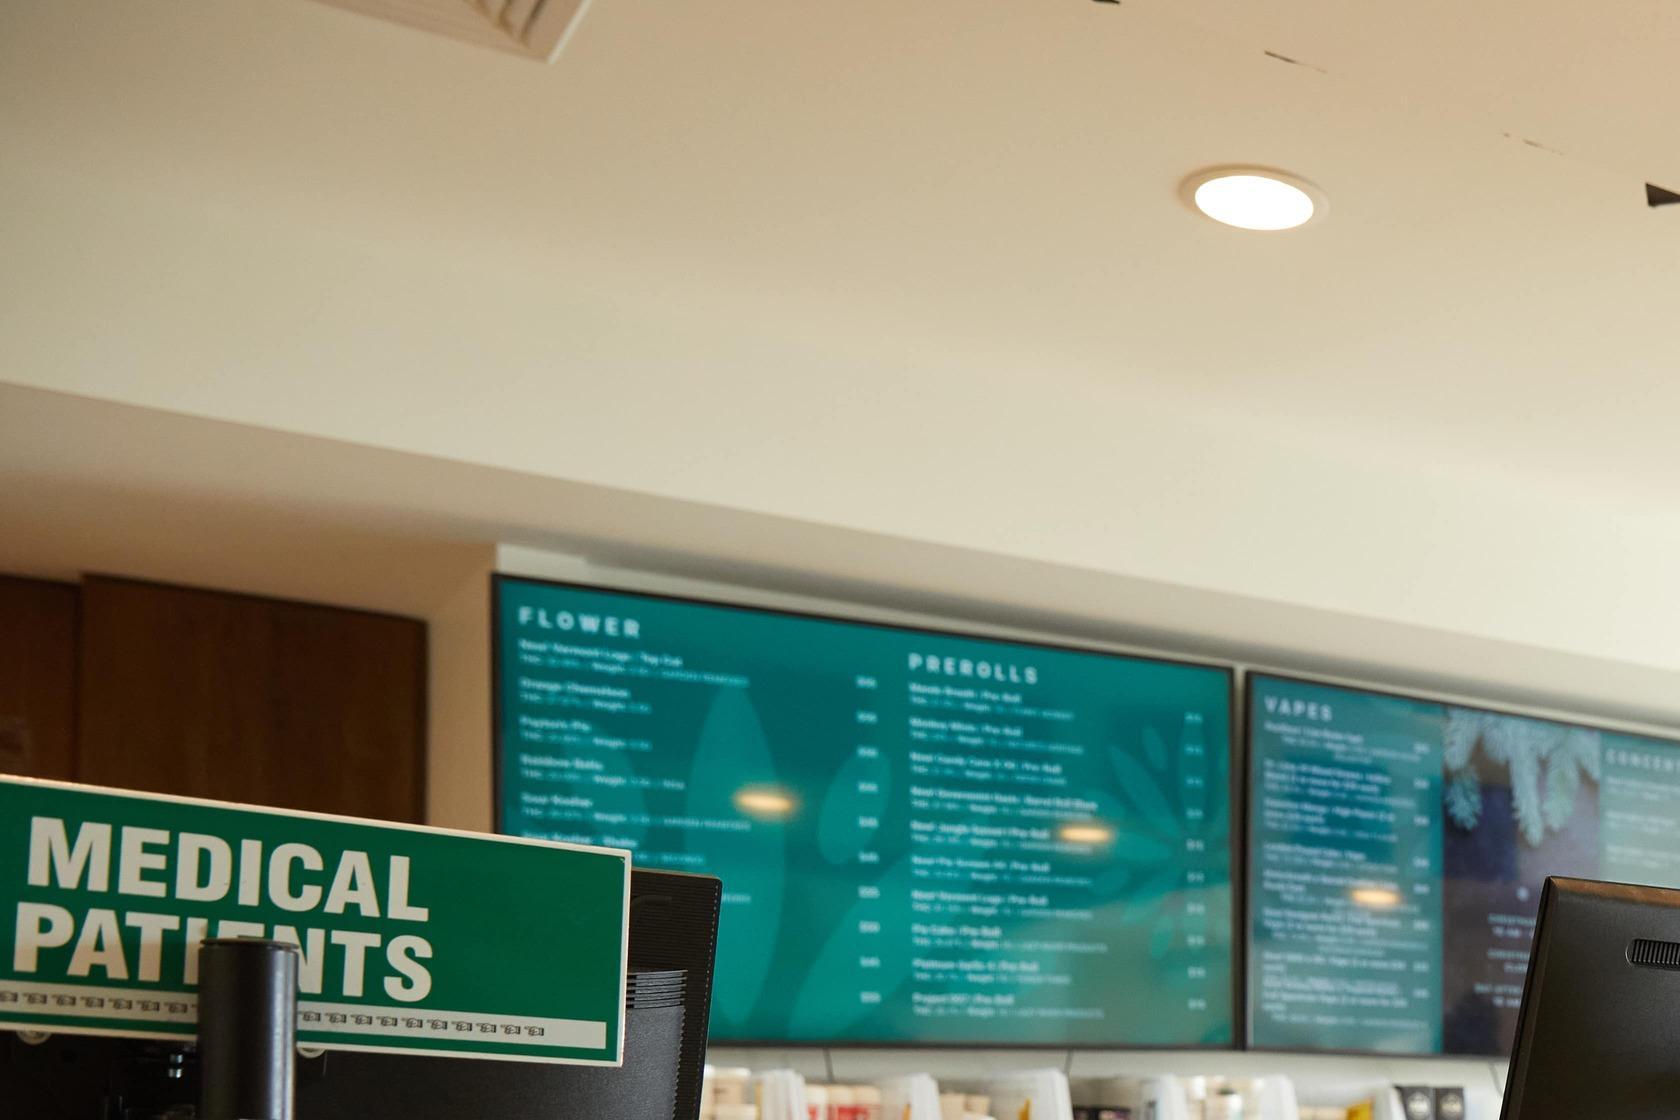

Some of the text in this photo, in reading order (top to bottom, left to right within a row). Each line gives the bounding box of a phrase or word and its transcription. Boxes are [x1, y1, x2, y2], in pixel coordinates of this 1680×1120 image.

[518, 605, 641, 639] FLOWER
[908, 651, 1039, 685] PREROLLS
[1263, 695, 1333, 722] VAPES
[27, 816, 430, 923] MEDICAL
[13, 902, 433, 1002] PATINTS
